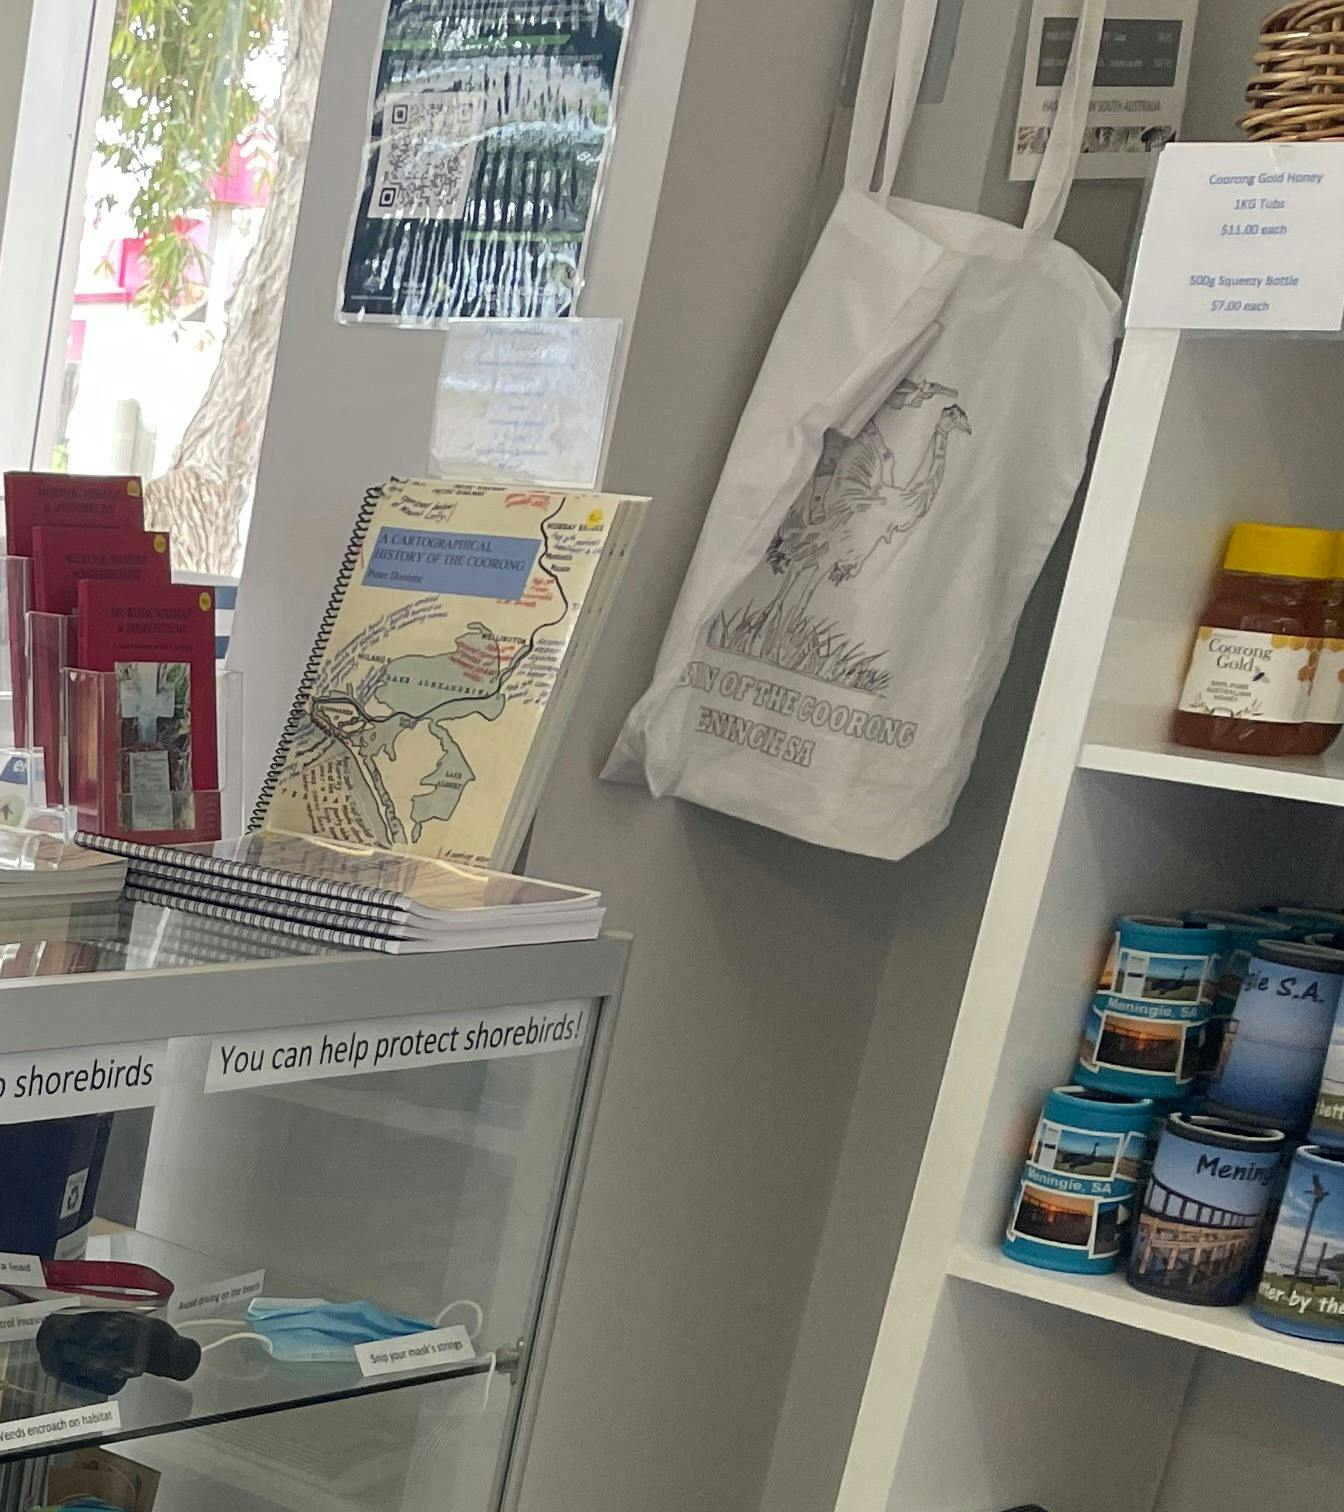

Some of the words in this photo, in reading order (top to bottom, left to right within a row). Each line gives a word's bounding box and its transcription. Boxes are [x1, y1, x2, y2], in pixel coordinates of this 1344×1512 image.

[1208, 173, 1255, 187] Coorong
[1258, 172, 1284, 185] Gold
[1286, 172, 1324, 186] Honey
[1234, 198, 1257, 210] 1KG
[1260, 198, 1286, 210] Tubs
[1221, 223, 1259, 237] $11.00
[1261, 224, 1287, 236] each
[1189, 274, 1216, 290] 500g
[1266, 274, 1299, 287] Bottle
[1243, 300, 1270, 312] each
[391, 534, 494, 554] CARTOGRAPHICAL
[374, 550, 424, 564] HISTORY
[426, 554, 442, 565] OF
[443, 556, 466, 567] THE
[467, 557, 526, 572] COORONG
[1208, 638, 1273, 661] Coorong
[1216, 654, 1255, 673] Gold
[720, 671, 752, 701] OF
[752, 679, 802, 717] THE
[797, 694, 919, 750] COORONG
[782, 734, 818, 768] SA
[1276, 977, 1325, 1003] S.A.
[1179, 1004, 1199, 1018] SA
[220, 1042, 265, 1077] You
[271, 1042, 313, 1071] can
[319, 1029, 369, 1071] help
[374, 1025, 459, 1068] protect
[463, 1010, 583, 1051] shorebirds!
[13, 1055, 155, 1101] shorebirds
[1090, 1181, 1113, 1195] SA
[9, 1262, 32, 1273] lead
[369, 1350, 388, 1364] Snip
[388, 1348, 407, 1362] your
[27, 1419, 68, 1437] encroach
[69, 1418, 81, 1429] on
[82, 1410, 113, 1426] habitat
